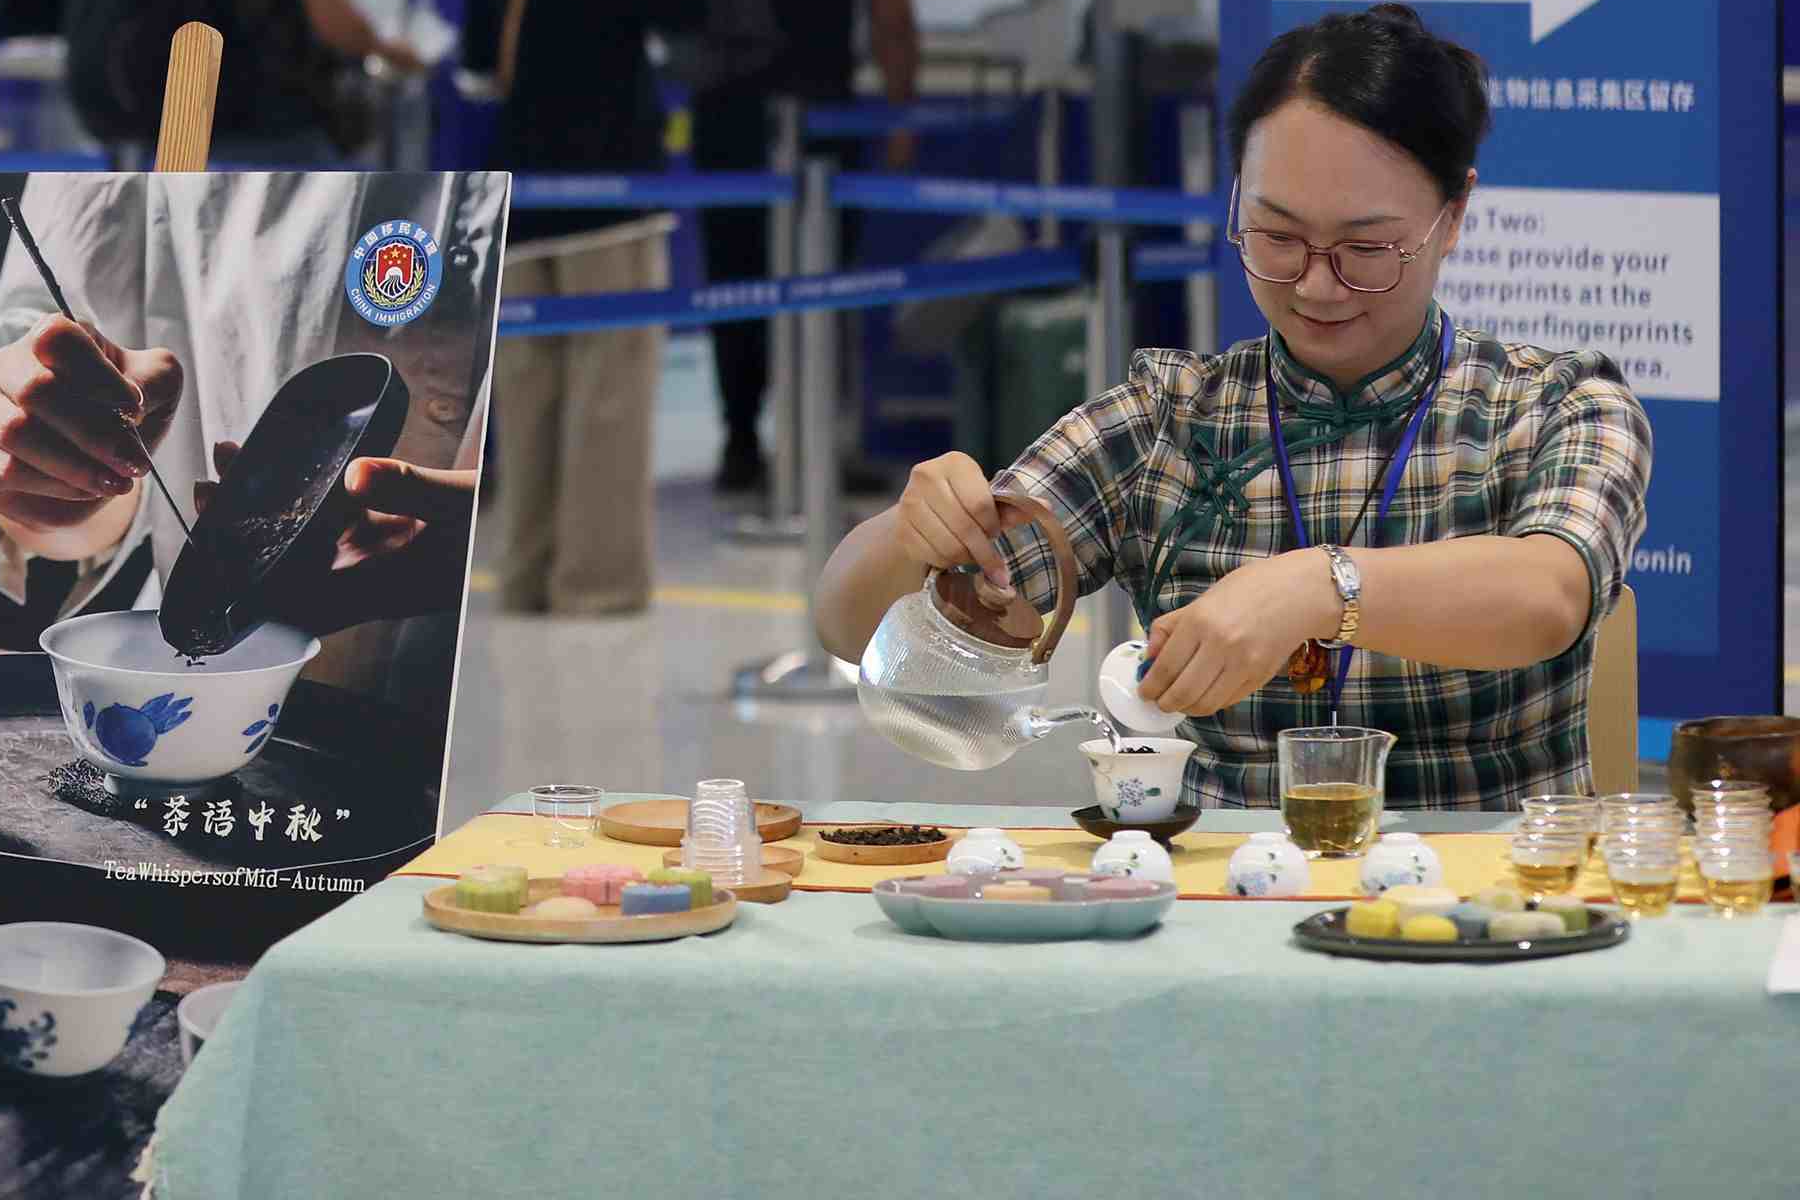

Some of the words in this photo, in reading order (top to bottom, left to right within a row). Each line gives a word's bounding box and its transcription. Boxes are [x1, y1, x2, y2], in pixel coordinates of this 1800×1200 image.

[353, 222, 439, 260] 中国移民管理
[1448, 246, 1501, 268] ease
[1509, 246, 1605, 274] provide
[1612, 253, 1669, 277] your
[351, 288, 373, 317] CHINA
[375, 283, 437, 323] IMMIGRATION
[1439, 277, 1571, 306] ngerprints
[1579, 282, 1602, 304] at
[1611, 283, 1653, 307] the
